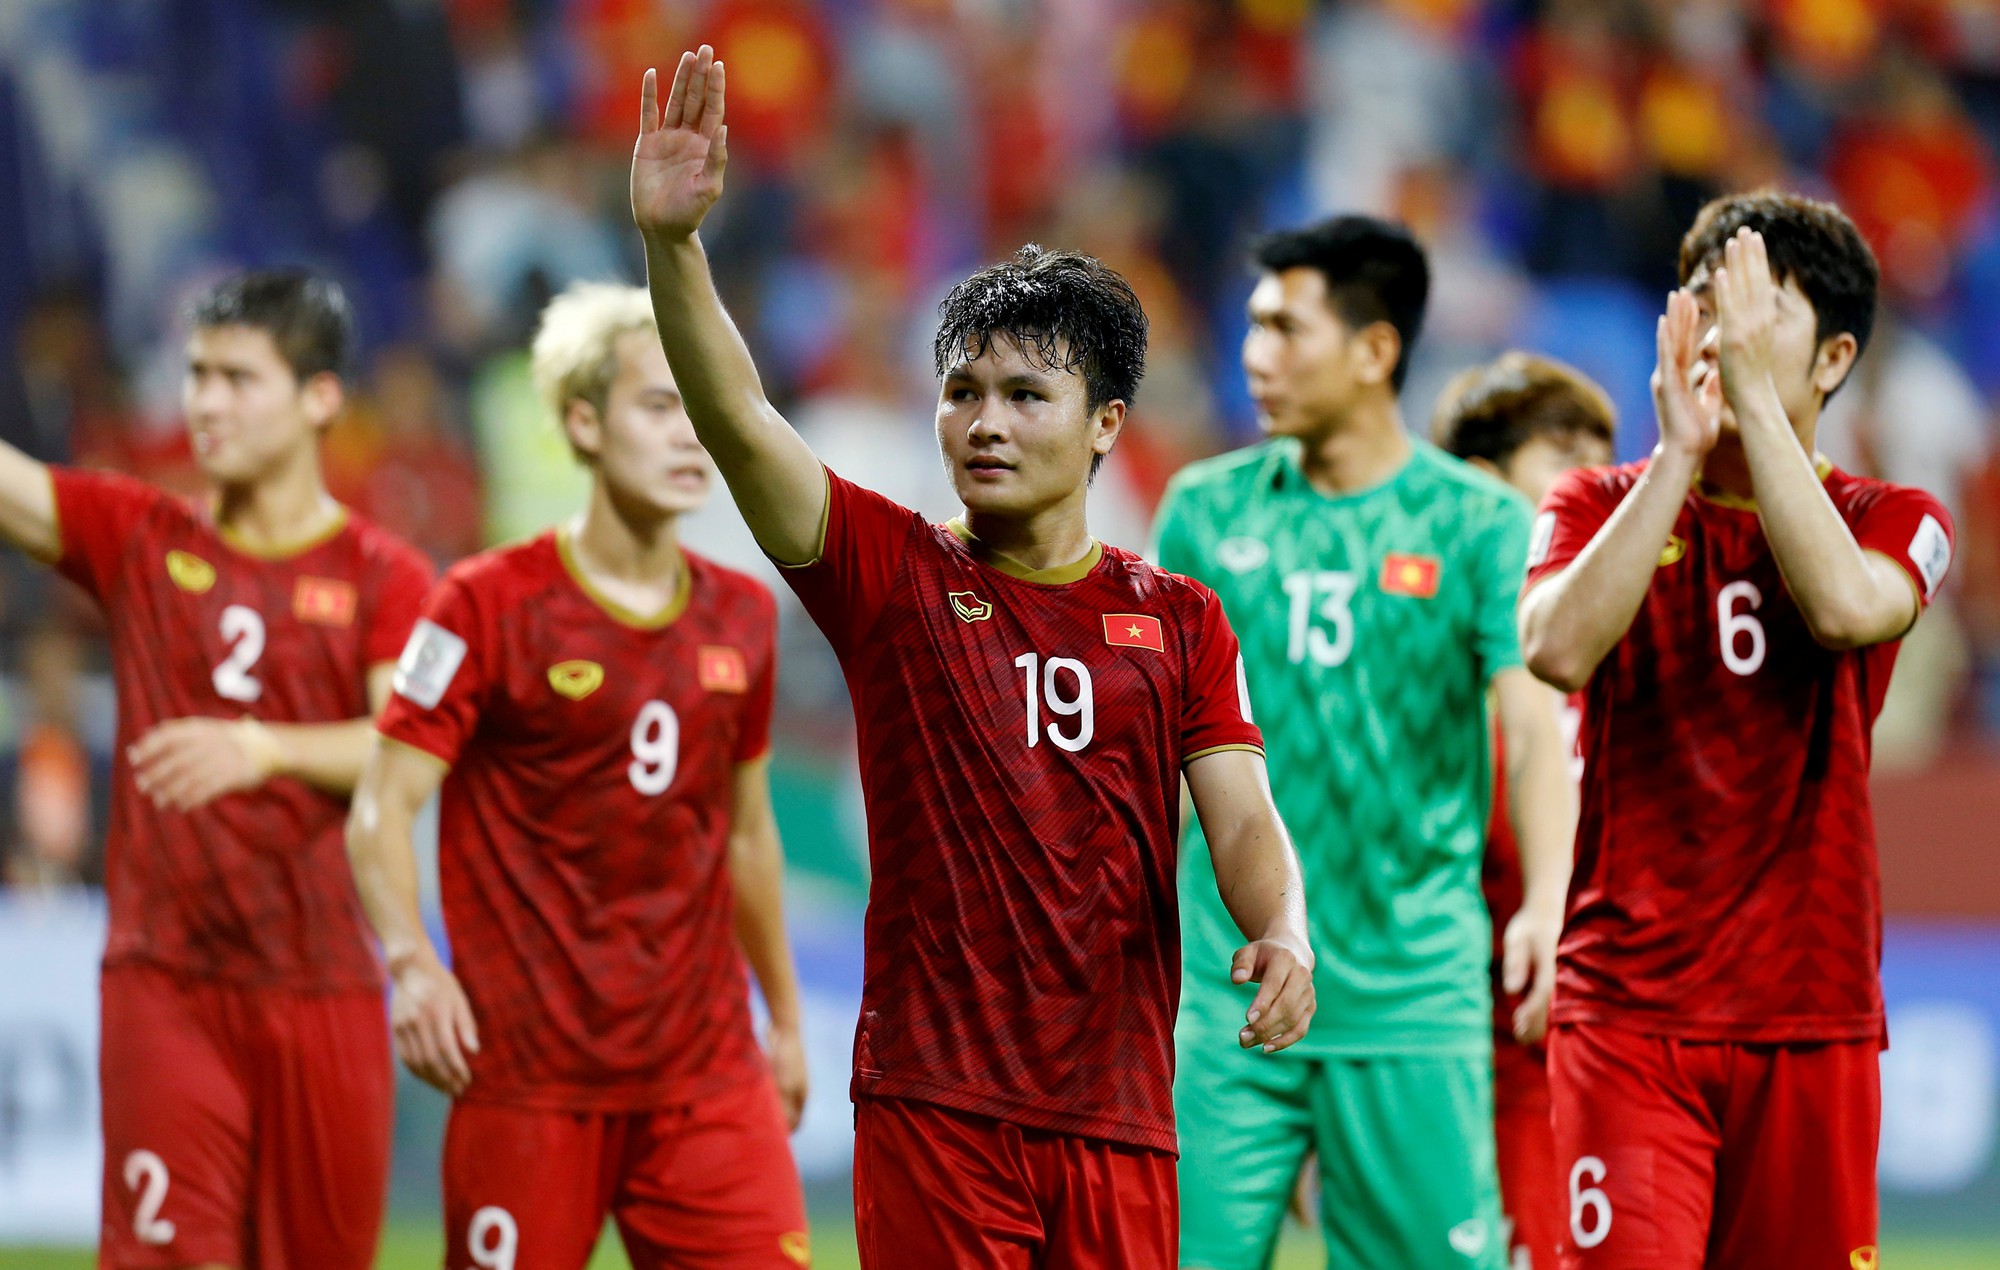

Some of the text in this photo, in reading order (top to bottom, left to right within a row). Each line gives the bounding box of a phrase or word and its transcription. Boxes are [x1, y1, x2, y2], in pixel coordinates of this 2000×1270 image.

[213, 605, 265, 701] 2
[1282, 570, 1356, 666] 13
[1717, 581, 1766, 676] 6
[628, 700, 679, 795] 9
[1015, 652, 1094, 753] 19
[124, 1150, 175, 1243] 2
[468, 1206, 518, 1270] 9
[1568, 1156, 1613, 1248] 6
